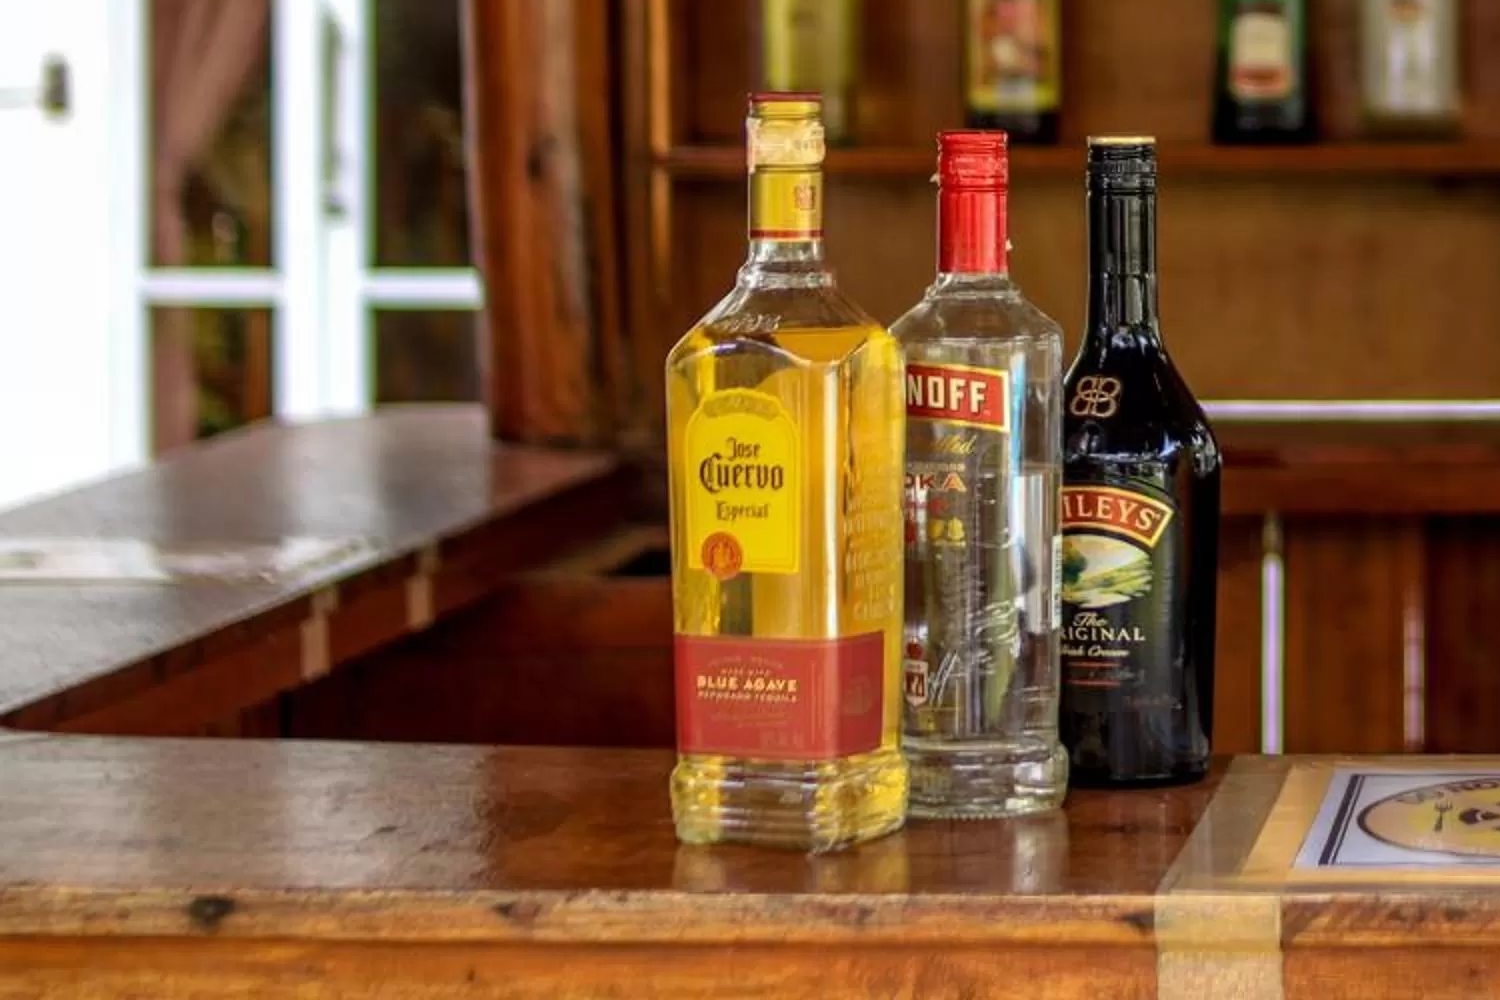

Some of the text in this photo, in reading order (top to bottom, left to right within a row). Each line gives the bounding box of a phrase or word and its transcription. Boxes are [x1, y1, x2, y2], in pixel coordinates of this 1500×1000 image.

[907, 373, 986, 413] NOFF
[725, 436, 761, 462] Jose
[699, 452, 784, 495] Cuervo
[1062, 494, 1152, 531] ILEYS
[1060, 626, 1146, 642] IGINAL
[697, 675, 797, 693] BLUE AGAVE
